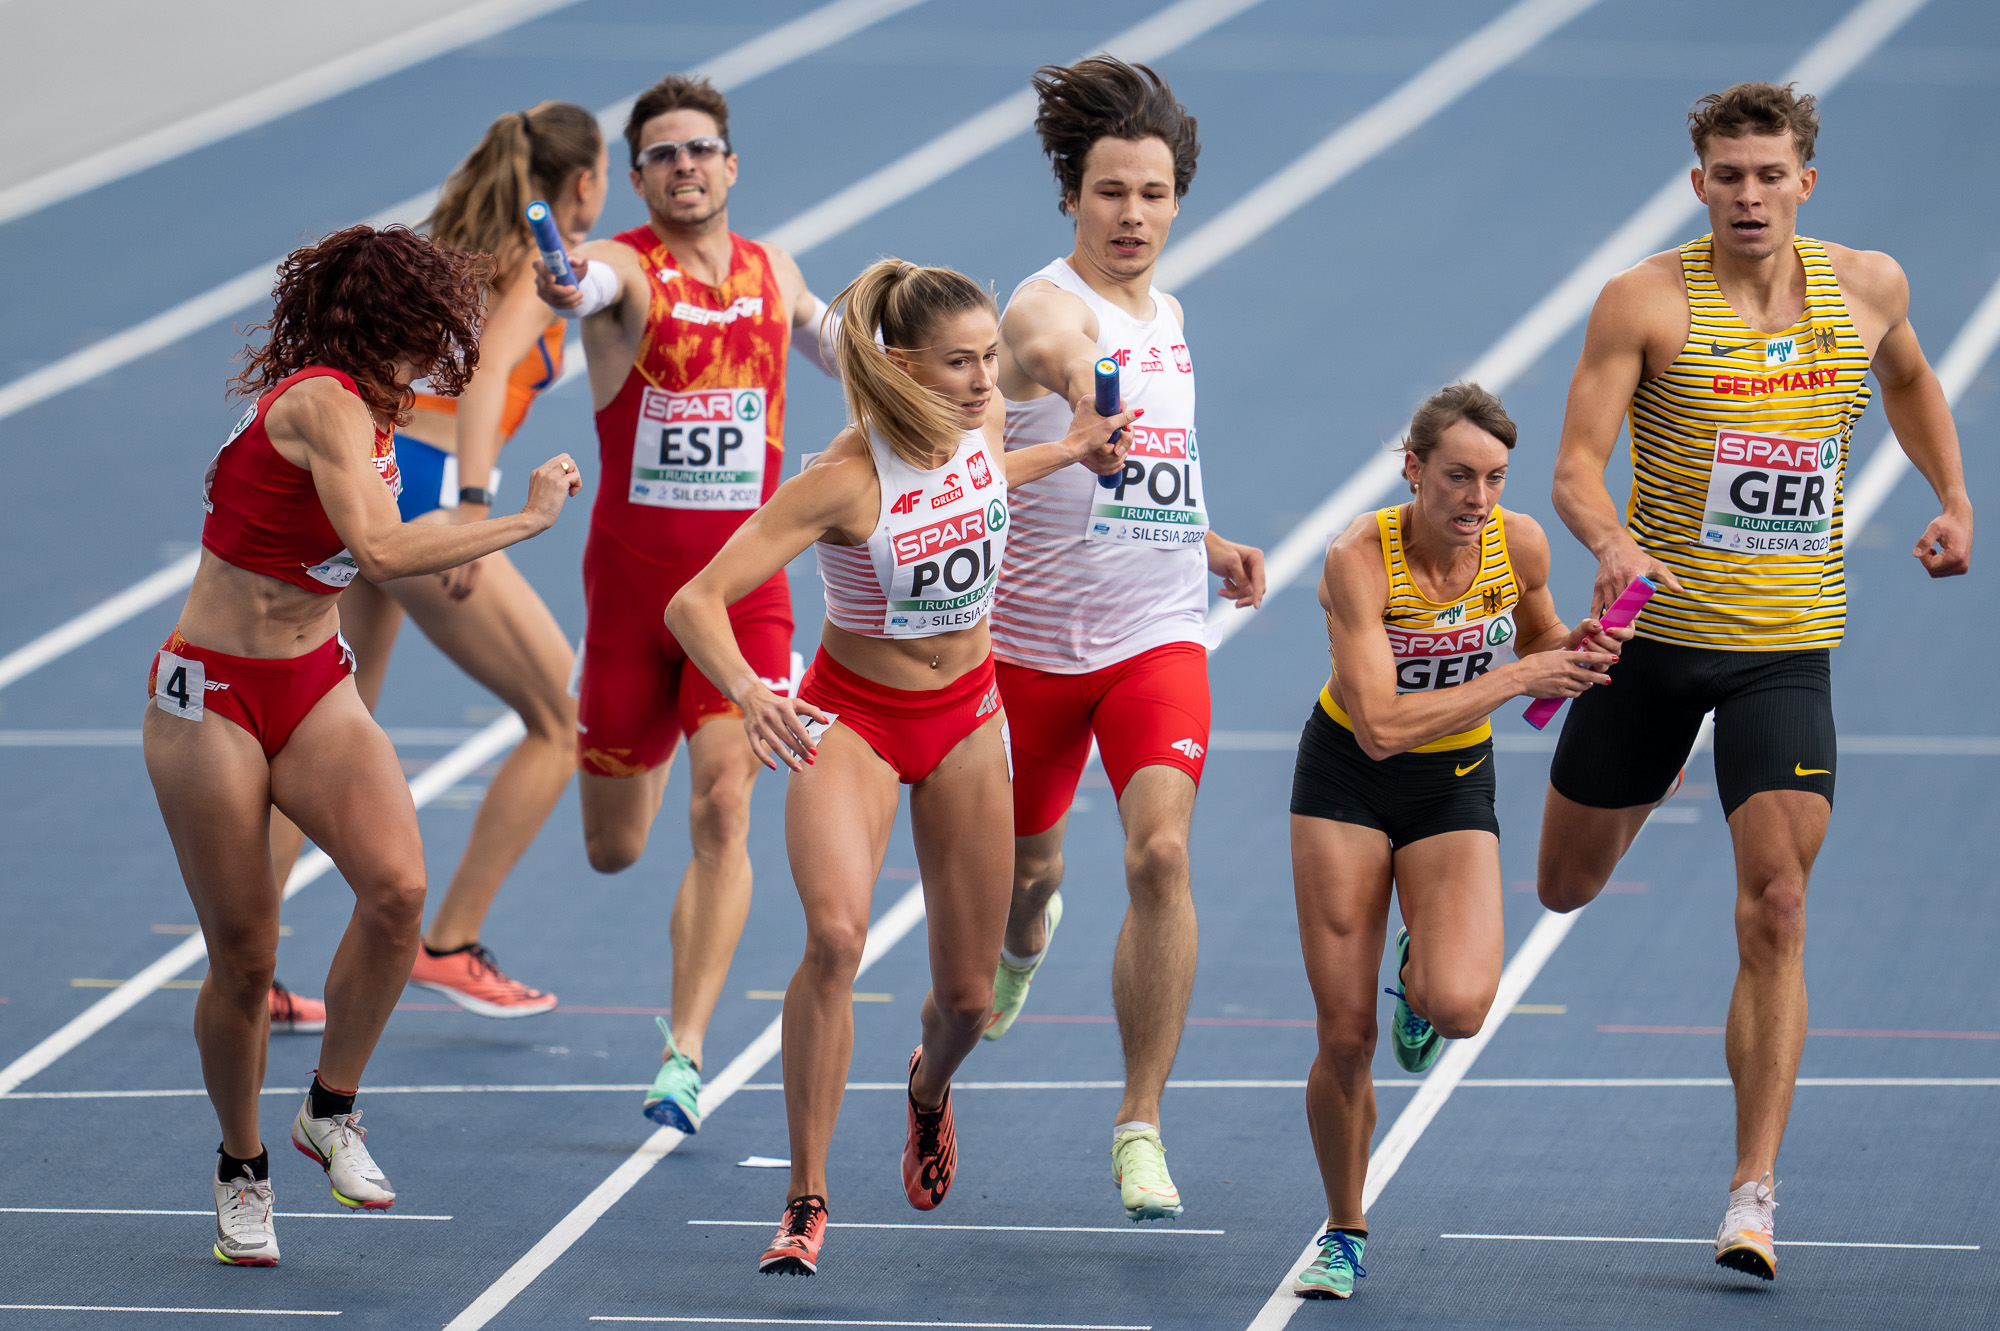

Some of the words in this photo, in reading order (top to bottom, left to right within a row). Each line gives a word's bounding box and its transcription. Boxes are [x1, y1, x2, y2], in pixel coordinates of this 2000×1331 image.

[671, 296, 763, 326] ESPAÑA
[1712, 367, 1839, 396] GERMANY
[647, 395, 730, 420] SPAR
[659, 427, 743, 466] ESP
[1129, 429, 1185, 454] PAR
[1720, 437, 1817, 467] SPAR
[672, 488, 725, 501] SILESIA
[1114, 460, 1197, 507] POL
[1730, 471, 1826, 517] GER
[890, 489, 923, 515] 4F
[933, 489, 962, 507] ORLEN
[1121, 508, 1126, 518] I
[1127, 508, 1154, 520] RUN
[1132, 527, 1180, 543] SILESIA
[1734, 516, 1739, 527] I
[1741, 517, 1770, 530] RUN
[897, 514, 983, 561] SPAR
[1746, 536, 1799, 551] SILESIA
[1803, 536, 1829, 551] 2023
[910, 539, 996, 598] POL
[919, 601, 923, 610] I
[925, 600, 955, 610] RUN
[932, 606, 981, 626] SILESIA
[1389, 629, 1480, 654] SPAR
[1397, 652, 1493, 689] GER
[167, 666, 189, 709] 4
[204, 680, 230, 691] SP
[1171, 738, 1204, 760] 4F
